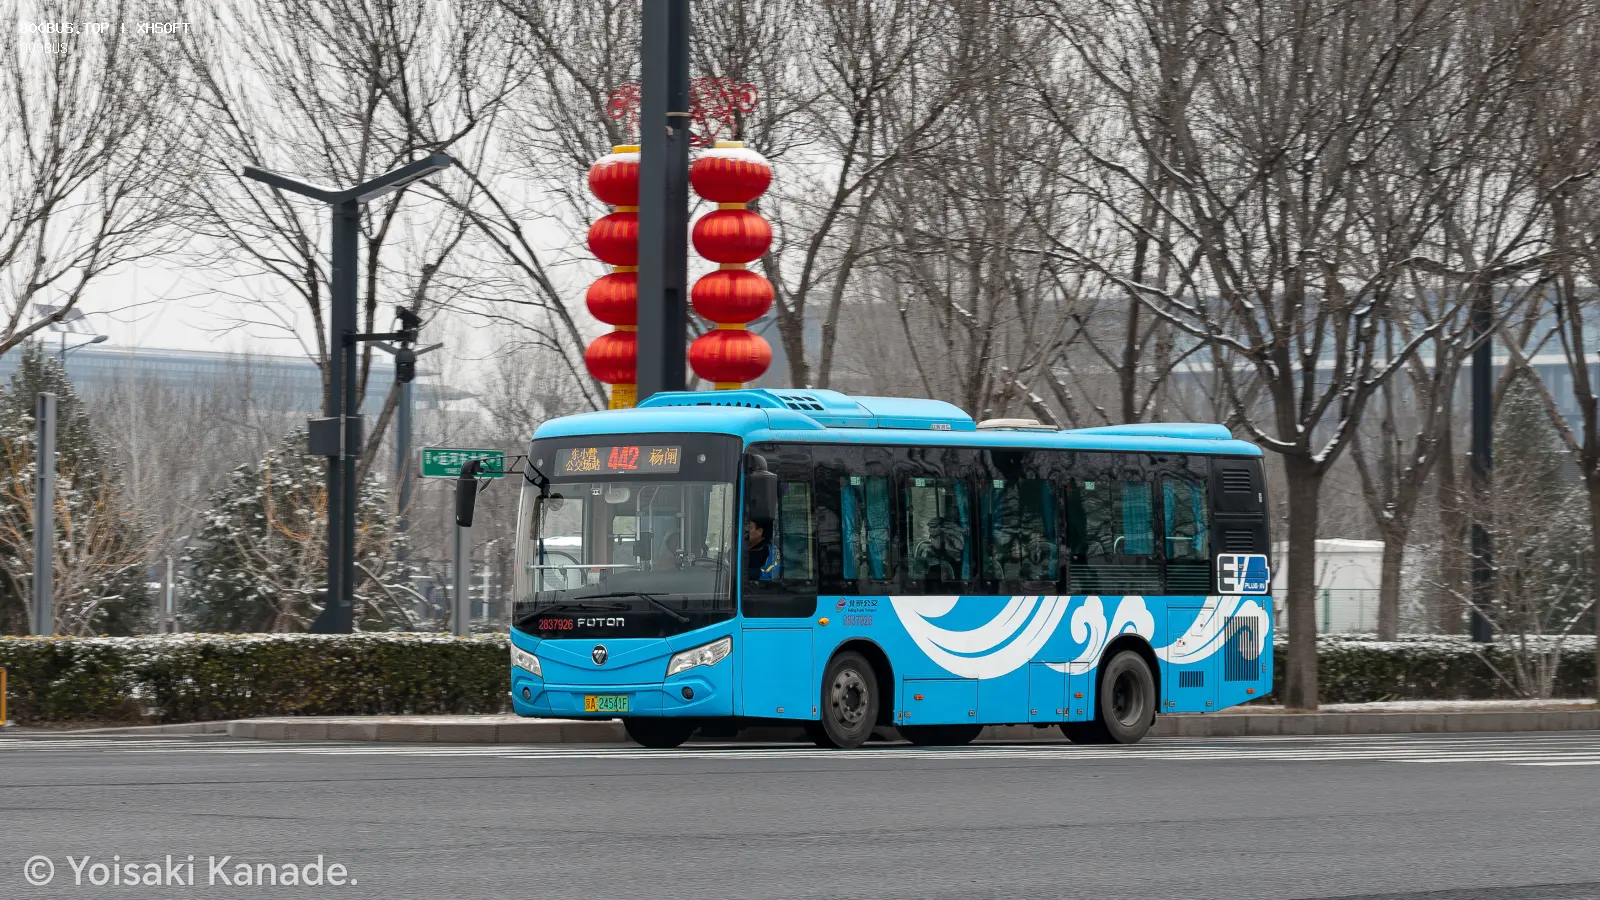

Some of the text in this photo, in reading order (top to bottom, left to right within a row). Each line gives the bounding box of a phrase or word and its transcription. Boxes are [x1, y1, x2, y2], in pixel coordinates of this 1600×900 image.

[607, 446, 640, 470] 442
[1219, 555, 1250, 591] EV
[849, 599, 878, 607] 北京公交
[538, 618, 574, 630] 2837926
[577, 617, 625, 628] FOTON
[843, 615, 873, 626] 2837926
